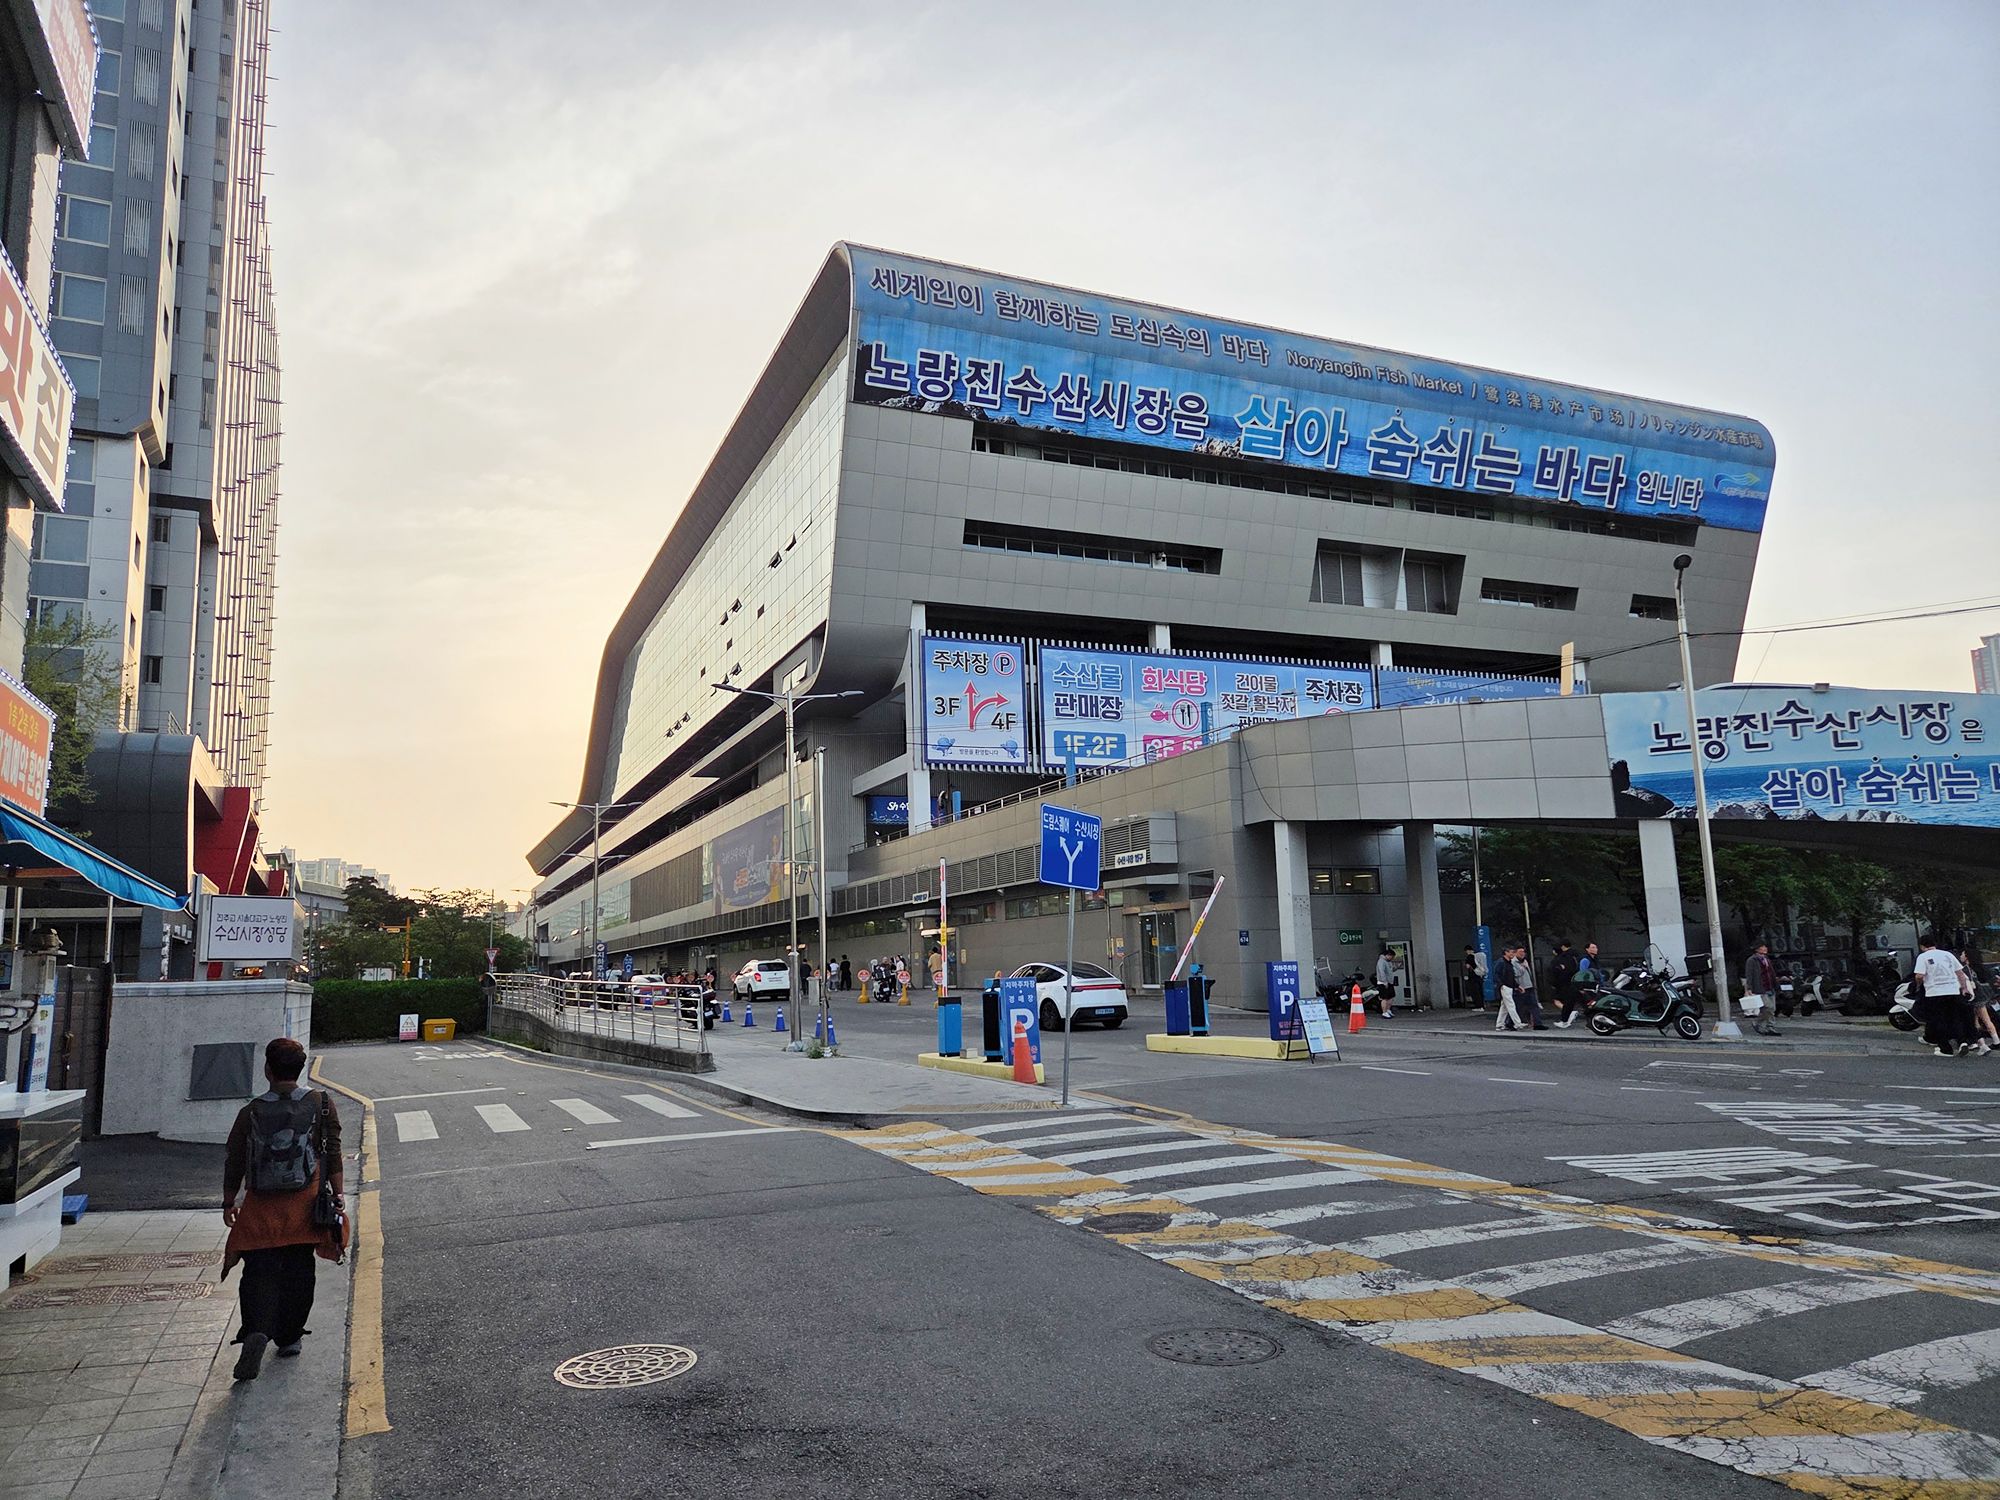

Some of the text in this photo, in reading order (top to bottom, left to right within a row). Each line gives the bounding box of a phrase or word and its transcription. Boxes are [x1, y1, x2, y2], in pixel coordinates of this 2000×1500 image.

[870, 266, 1271, 367] 세계인이 함께하는 도심속의 바다
[1286, 349, 1464, 396] Noryangjin Fish Market
[864, 340, 1704, 512] 노량진수산시장은 살아 숨쉬는 바다 입니다
[933, 650, 989, 675] 주차장
[1053, 661, 1123, 691] 수산물
[1141, 666, 1208, 696] 회식당
[1235, 673, 1278, 692] 건어물
[1305, 679, 1363, 705] 주차장
[934, 696, 1018, 730] 3F 4F
[1053, 692, 1125, 722] 판매장
[1063, 733, 1119, 757] 1F,2F
[1760, 762, 1847, 810] 살아
[1856, 761, 1981, 805] 숨쉬는
[1074, 820, 1099, 841] 수산시장
[215, 925, 288, 943] 수산시장성당
[1005, 980, 1036, 989] 지하주차장
[1279, 990, 1295, 1015] P
[1010, 1008, 1035, 1043] P
